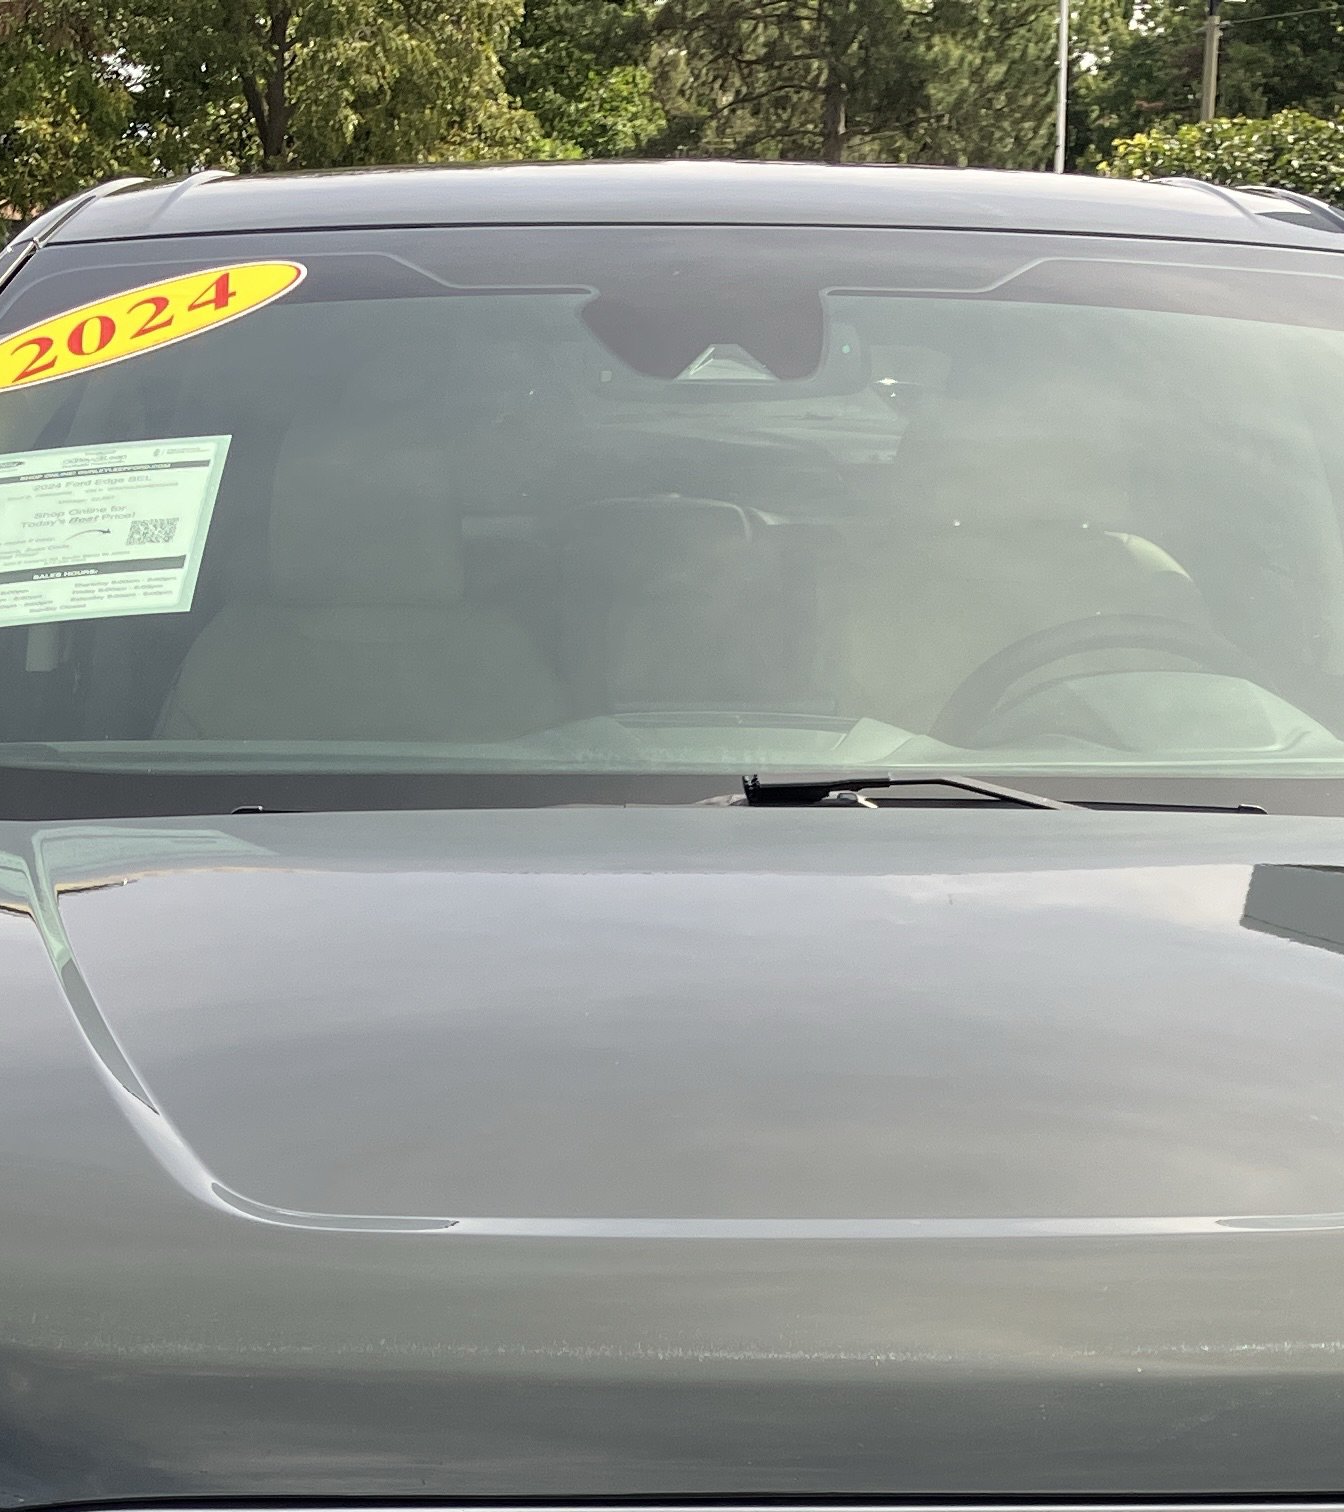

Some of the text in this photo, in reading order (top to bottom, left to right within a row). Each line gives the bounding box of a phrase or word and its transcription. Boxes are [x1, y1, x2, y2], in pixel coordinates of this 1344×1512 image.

[10, 272, 237, 384] 2024
[33, 482, 62, 491] 2024
[65, 479, 92, 488] Ford
[94, 477, 125, 486] Edge
[34, 504, 128, 520] Shop Online for
[68, 515, 100, 524] Best
[32, 572, 62, 580] SALES
